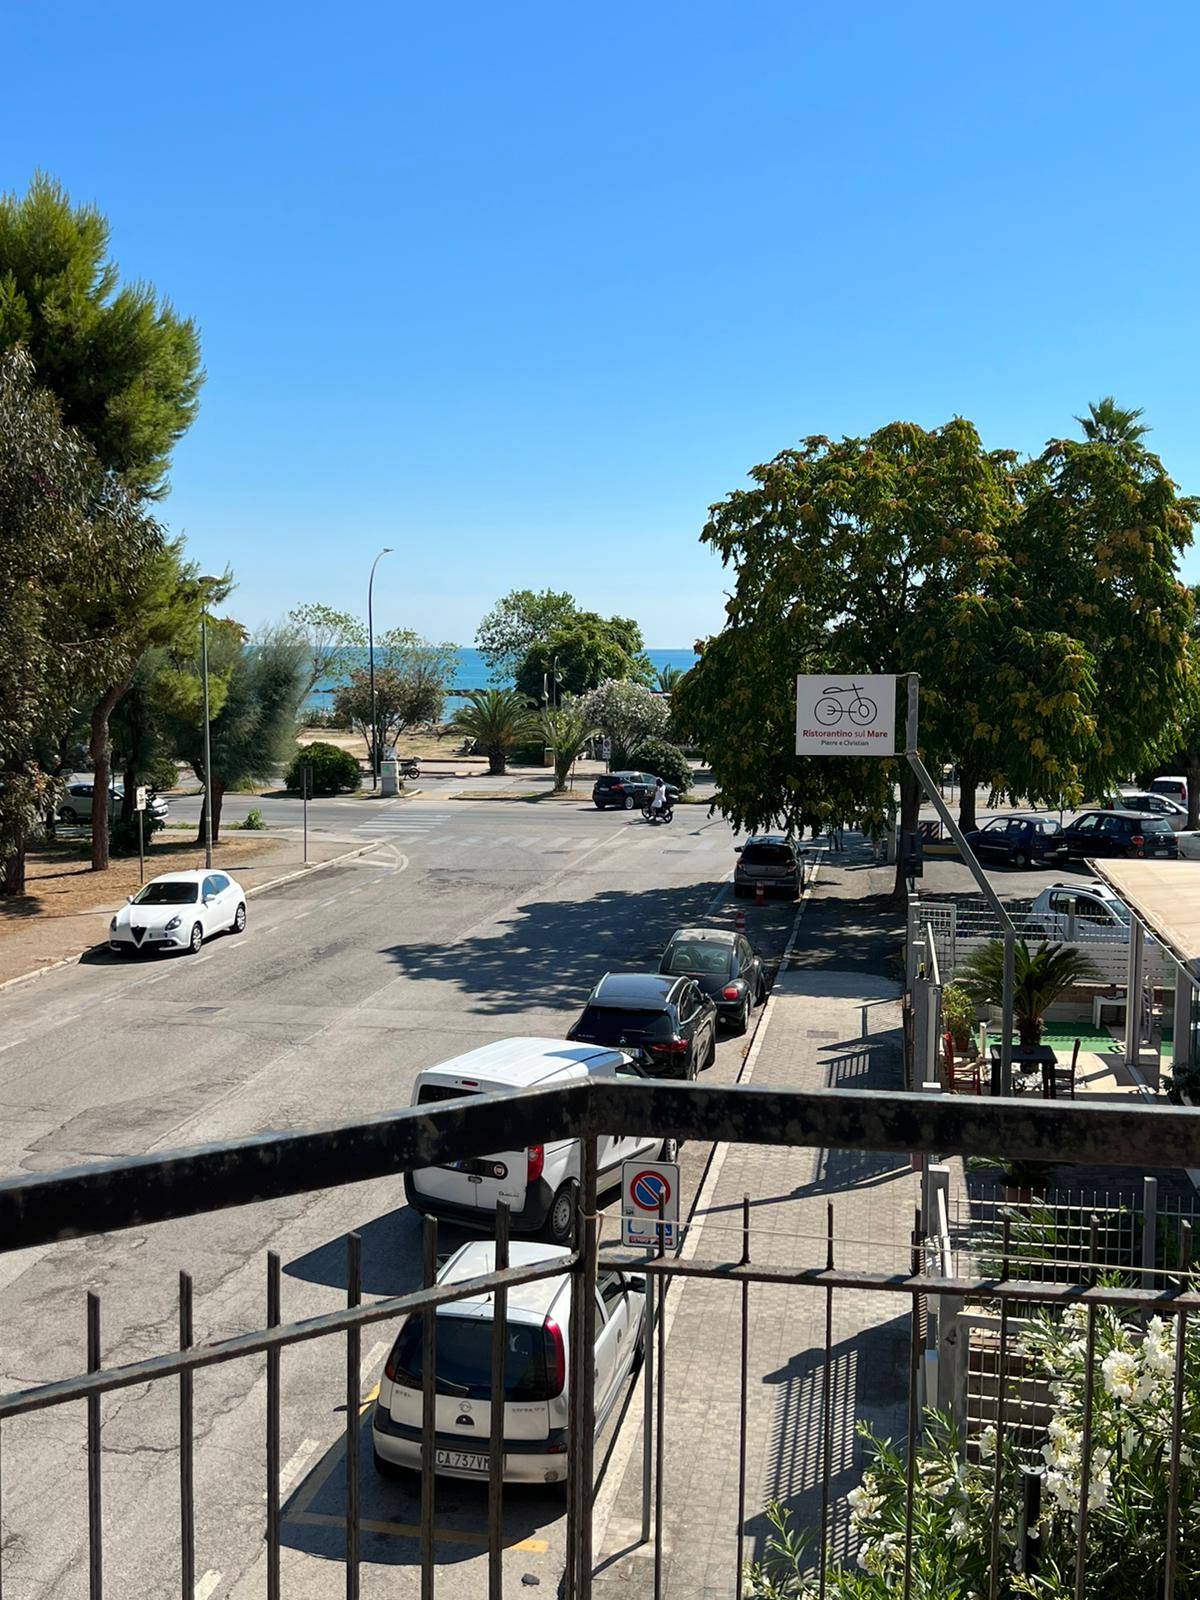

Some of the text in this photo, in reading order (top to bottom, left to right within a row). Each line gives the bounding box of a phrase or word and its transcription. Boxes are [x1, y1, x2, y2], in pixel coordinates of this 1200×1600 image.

[802, 729, 888, 738] Ristorantino sul Mare
